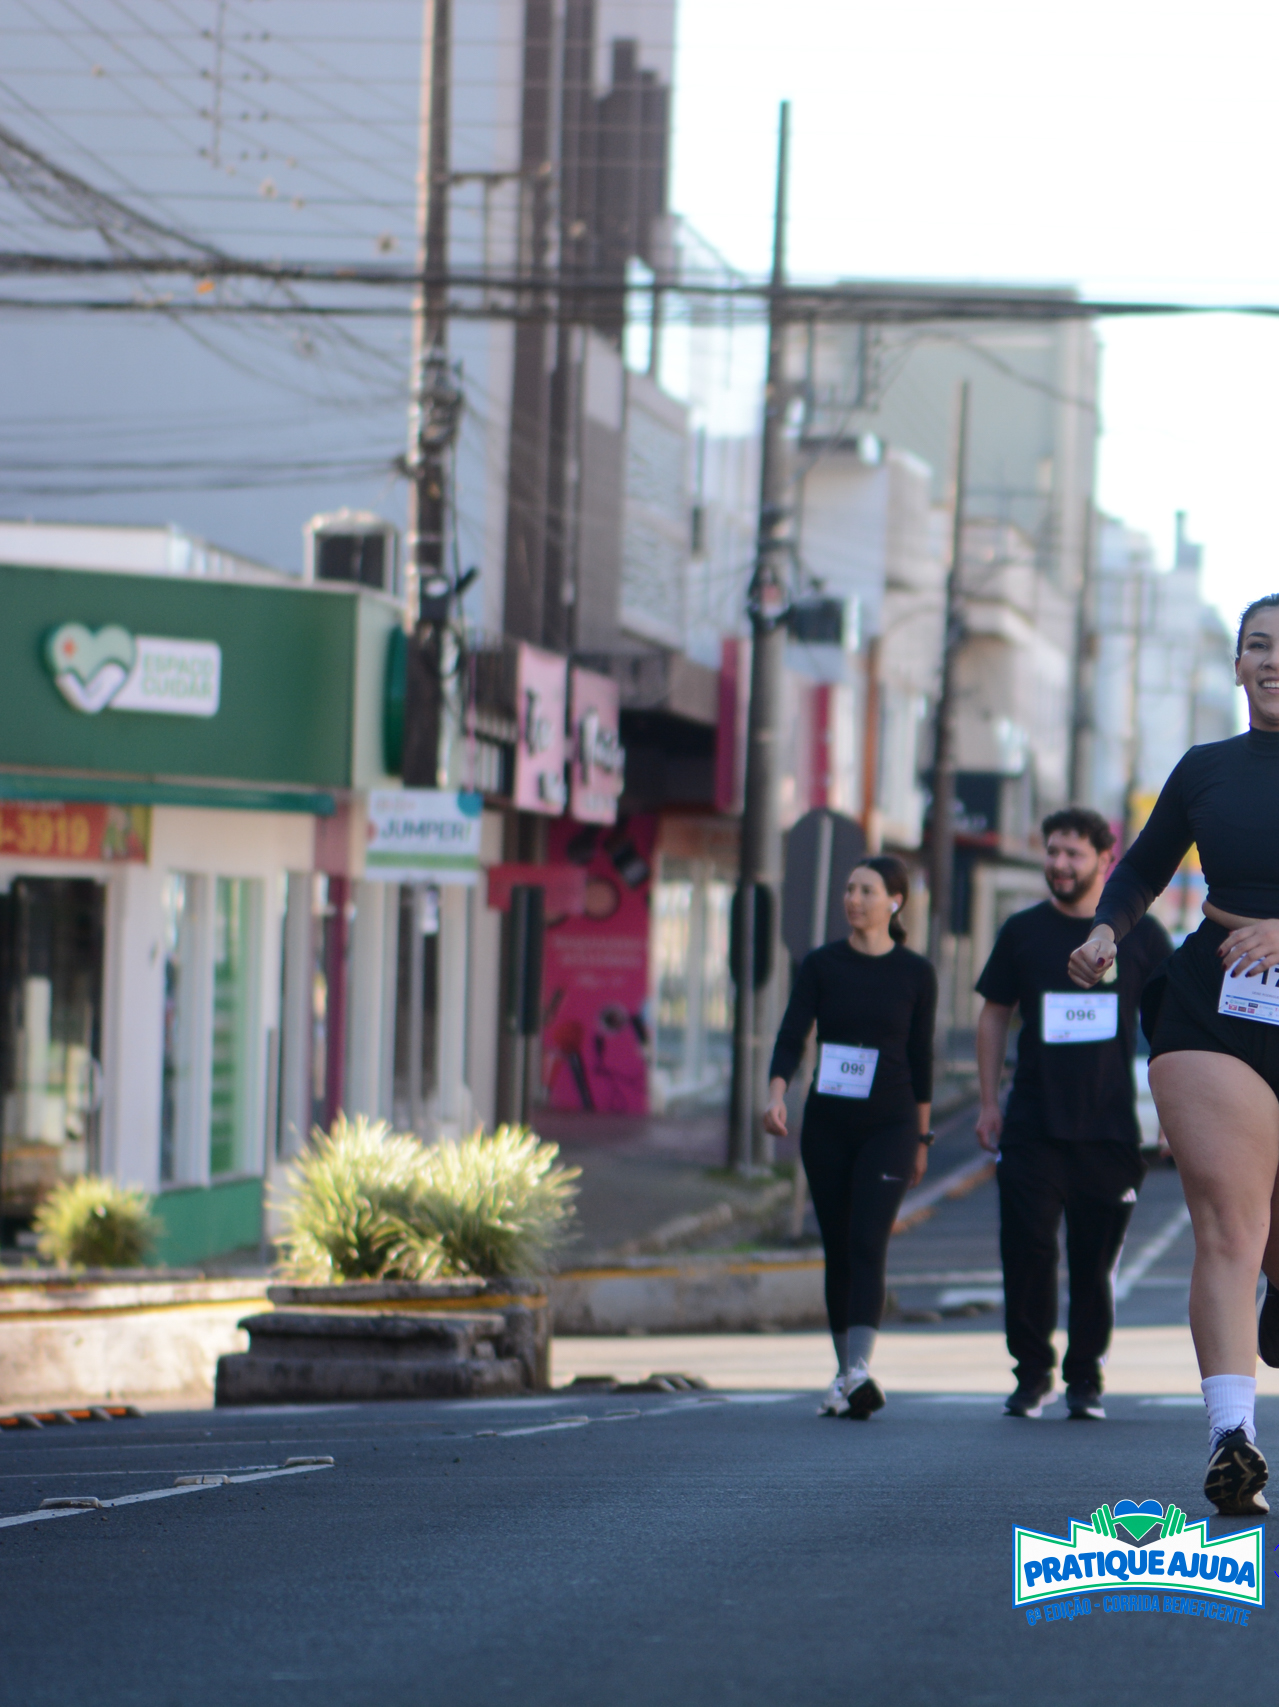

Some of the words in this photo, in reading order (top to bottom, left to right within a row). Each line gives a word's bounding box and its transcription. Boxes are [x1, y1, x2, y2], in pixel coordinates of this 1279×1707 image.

[141, 675, 213, 698] CUIDAR
[1065, 1009, 1096, 1021] 096
[840, 1061, 866, 1076] 099
